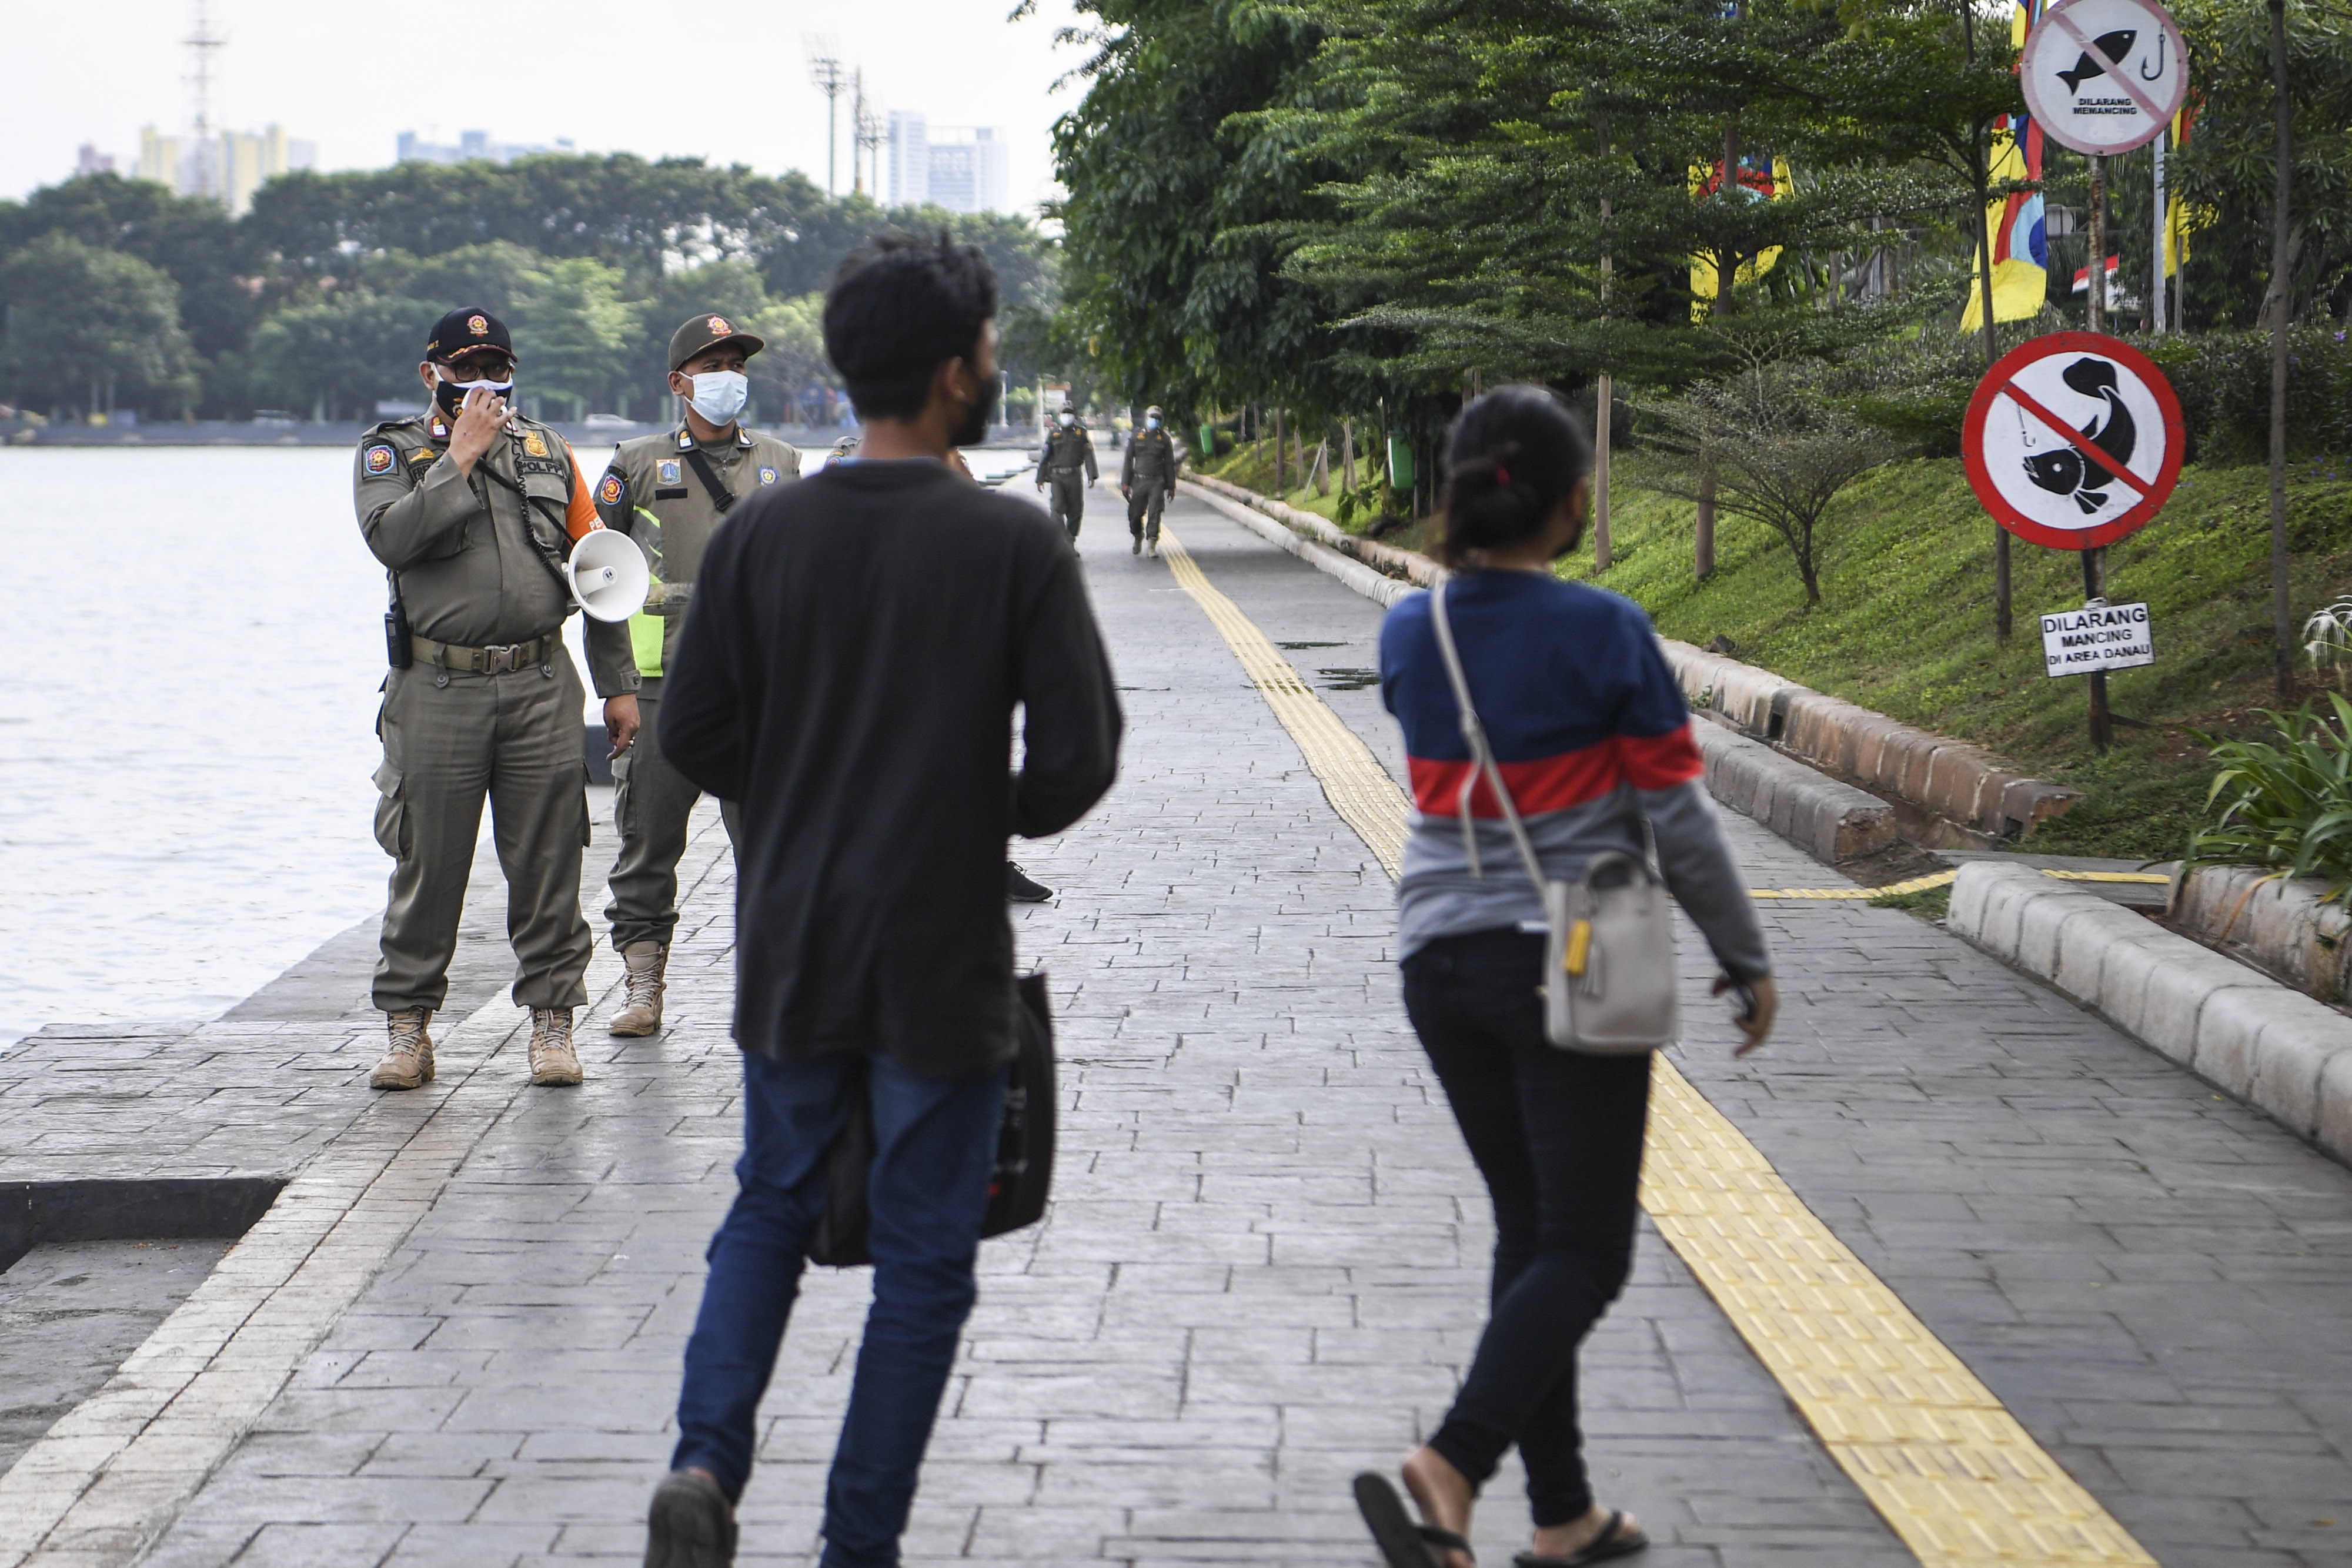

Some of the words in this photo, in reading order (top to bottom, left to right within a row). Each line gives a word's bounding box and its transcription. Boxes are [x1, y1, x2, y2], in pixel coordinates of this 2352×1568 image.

[2044, 607, 2146, 633] DILARANG
[2062, 628, 2133, 647] MANCING
[2049, 655, 2062, 665] DI
[2066, 650, 2101, 663] AREA
[2104, 644, 2150, 658] DANAU
